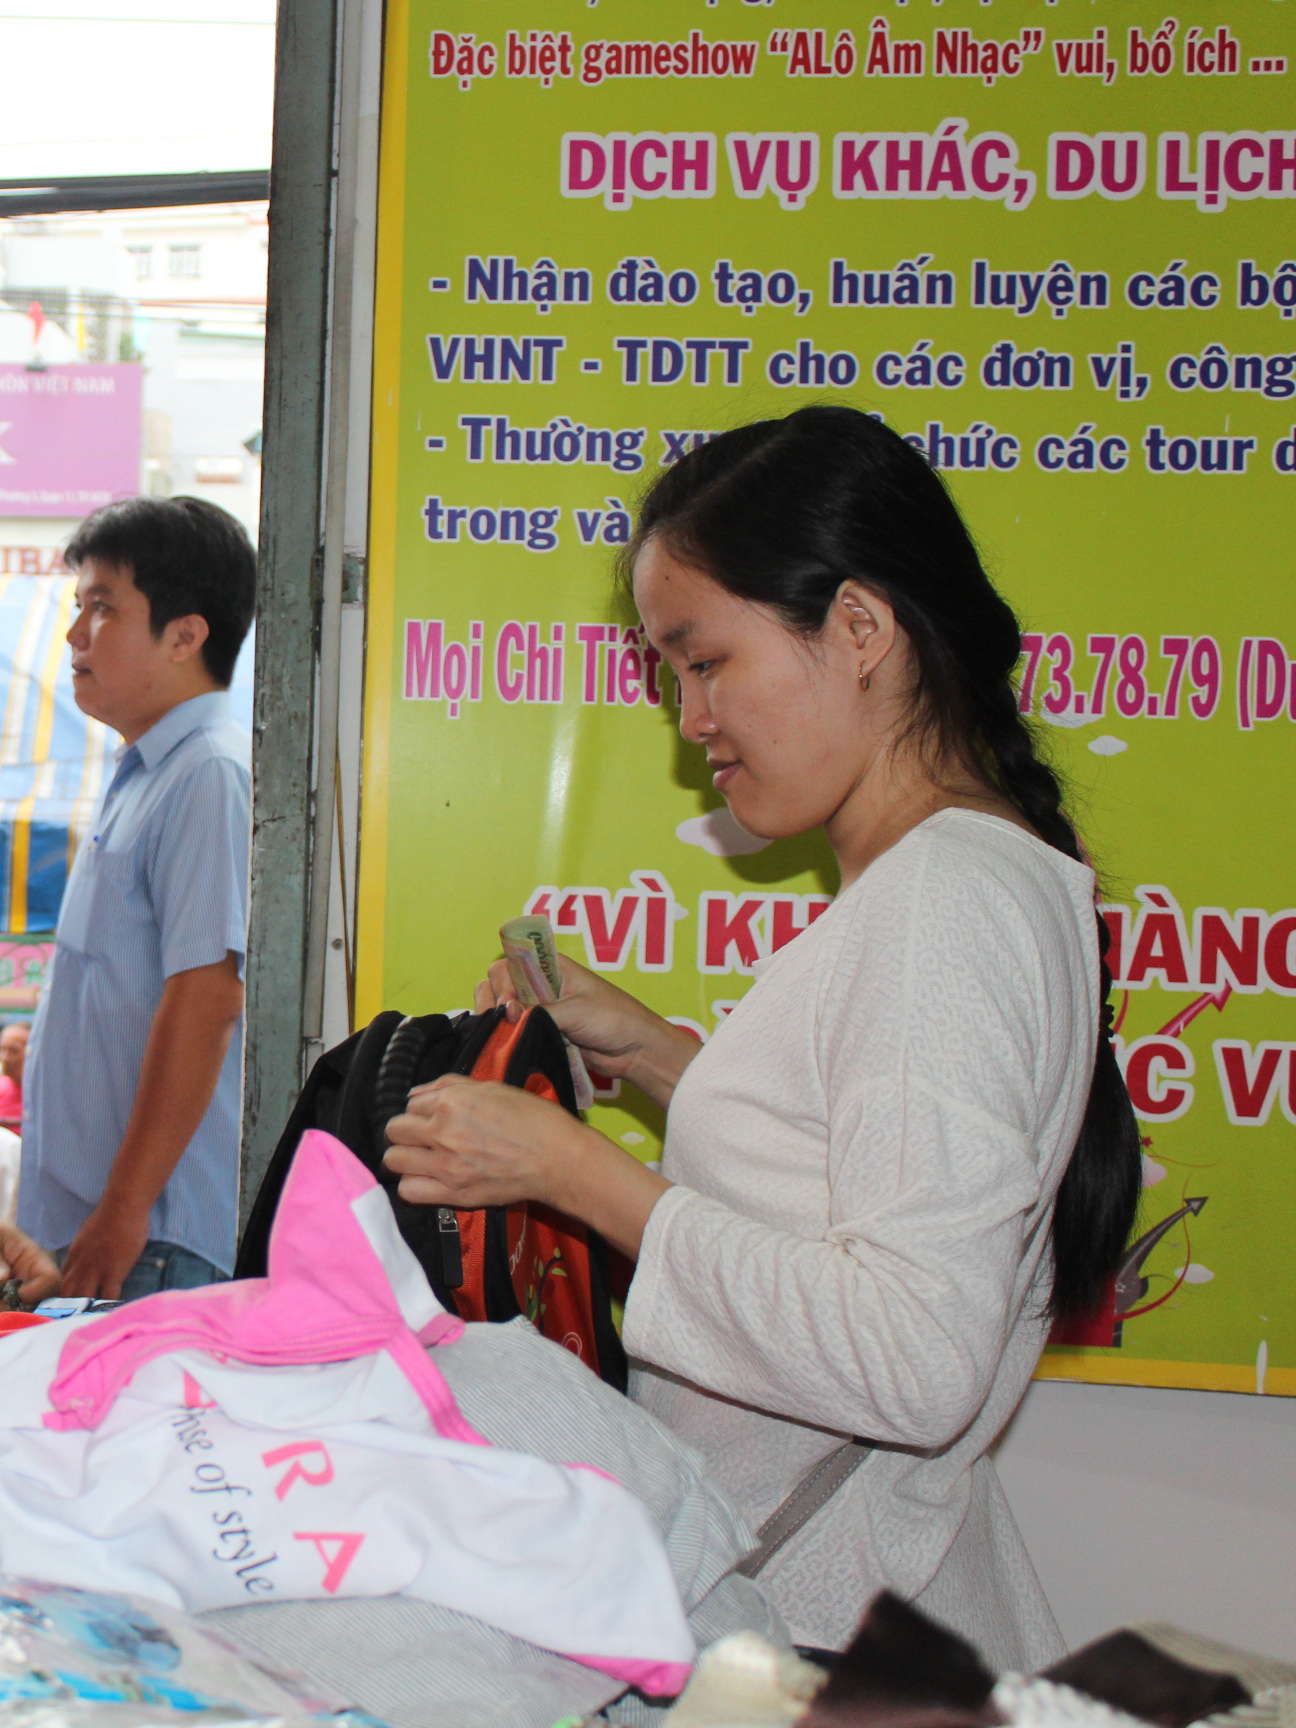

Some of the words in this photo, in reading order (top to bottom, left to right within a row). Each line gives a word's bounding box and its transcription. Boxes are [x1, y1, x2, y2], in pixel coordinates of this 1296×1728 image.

[431, 32, 496, 88] Đặc
[508, 32, 572, 86] biệt
[582, 31, 757, 85] gameshow
[867, 18, 923, 76] Âm
[935, 29, 1042, 85] Nhạc”
[1055, 29, 1116, 84] vui,
[1129, 19, 1177, 75] bổ
[1186, 27, 1237, 75] ích
[567, 138, 709, 204] DỊCH
[732, 139, 812, 204] VỤ
[840, 124, 1029, 204] KHÁC,
[1054, 138, 1140, 194] DU
[1164, 137, 1296, 206] LỊCH
[466, 257, 592, 314] Nhận
[608, 258, 698, 304] đào
[714, 260, 814, 315] tạo,
[831, 253, 954, 307] huấn
[973, 260, 1109, 318] luyện
[1126, 261, 1219, 308] các
[428, 336, 565, 382] VHNT
[615, 338, 751, 385] TDTT
[767, 339, 857, 386] cho
[874, 341, 965, 387] các
[982, 342, 1072, 389] đơn
[1090, 343, 1150, 400] vị,
[1168, 344, 1296, 398] công
[460, 417, 646, 472] Thường
[1036, 424, 1128, 472] các
[1145, 426, 1256, 473] tour
[424, 497, 559, 551] trong
[576, 499, 631, 544] và
[404, 619, 484, 718] Mọi
[496, 621, 564, 702] Chi
[576, 620, 663, 706] Tiết
[1018, 633, 1221, 719] 73.78.79
[189, 1462, 253, 1496] of
[212, 1510, 279, 1595] style
